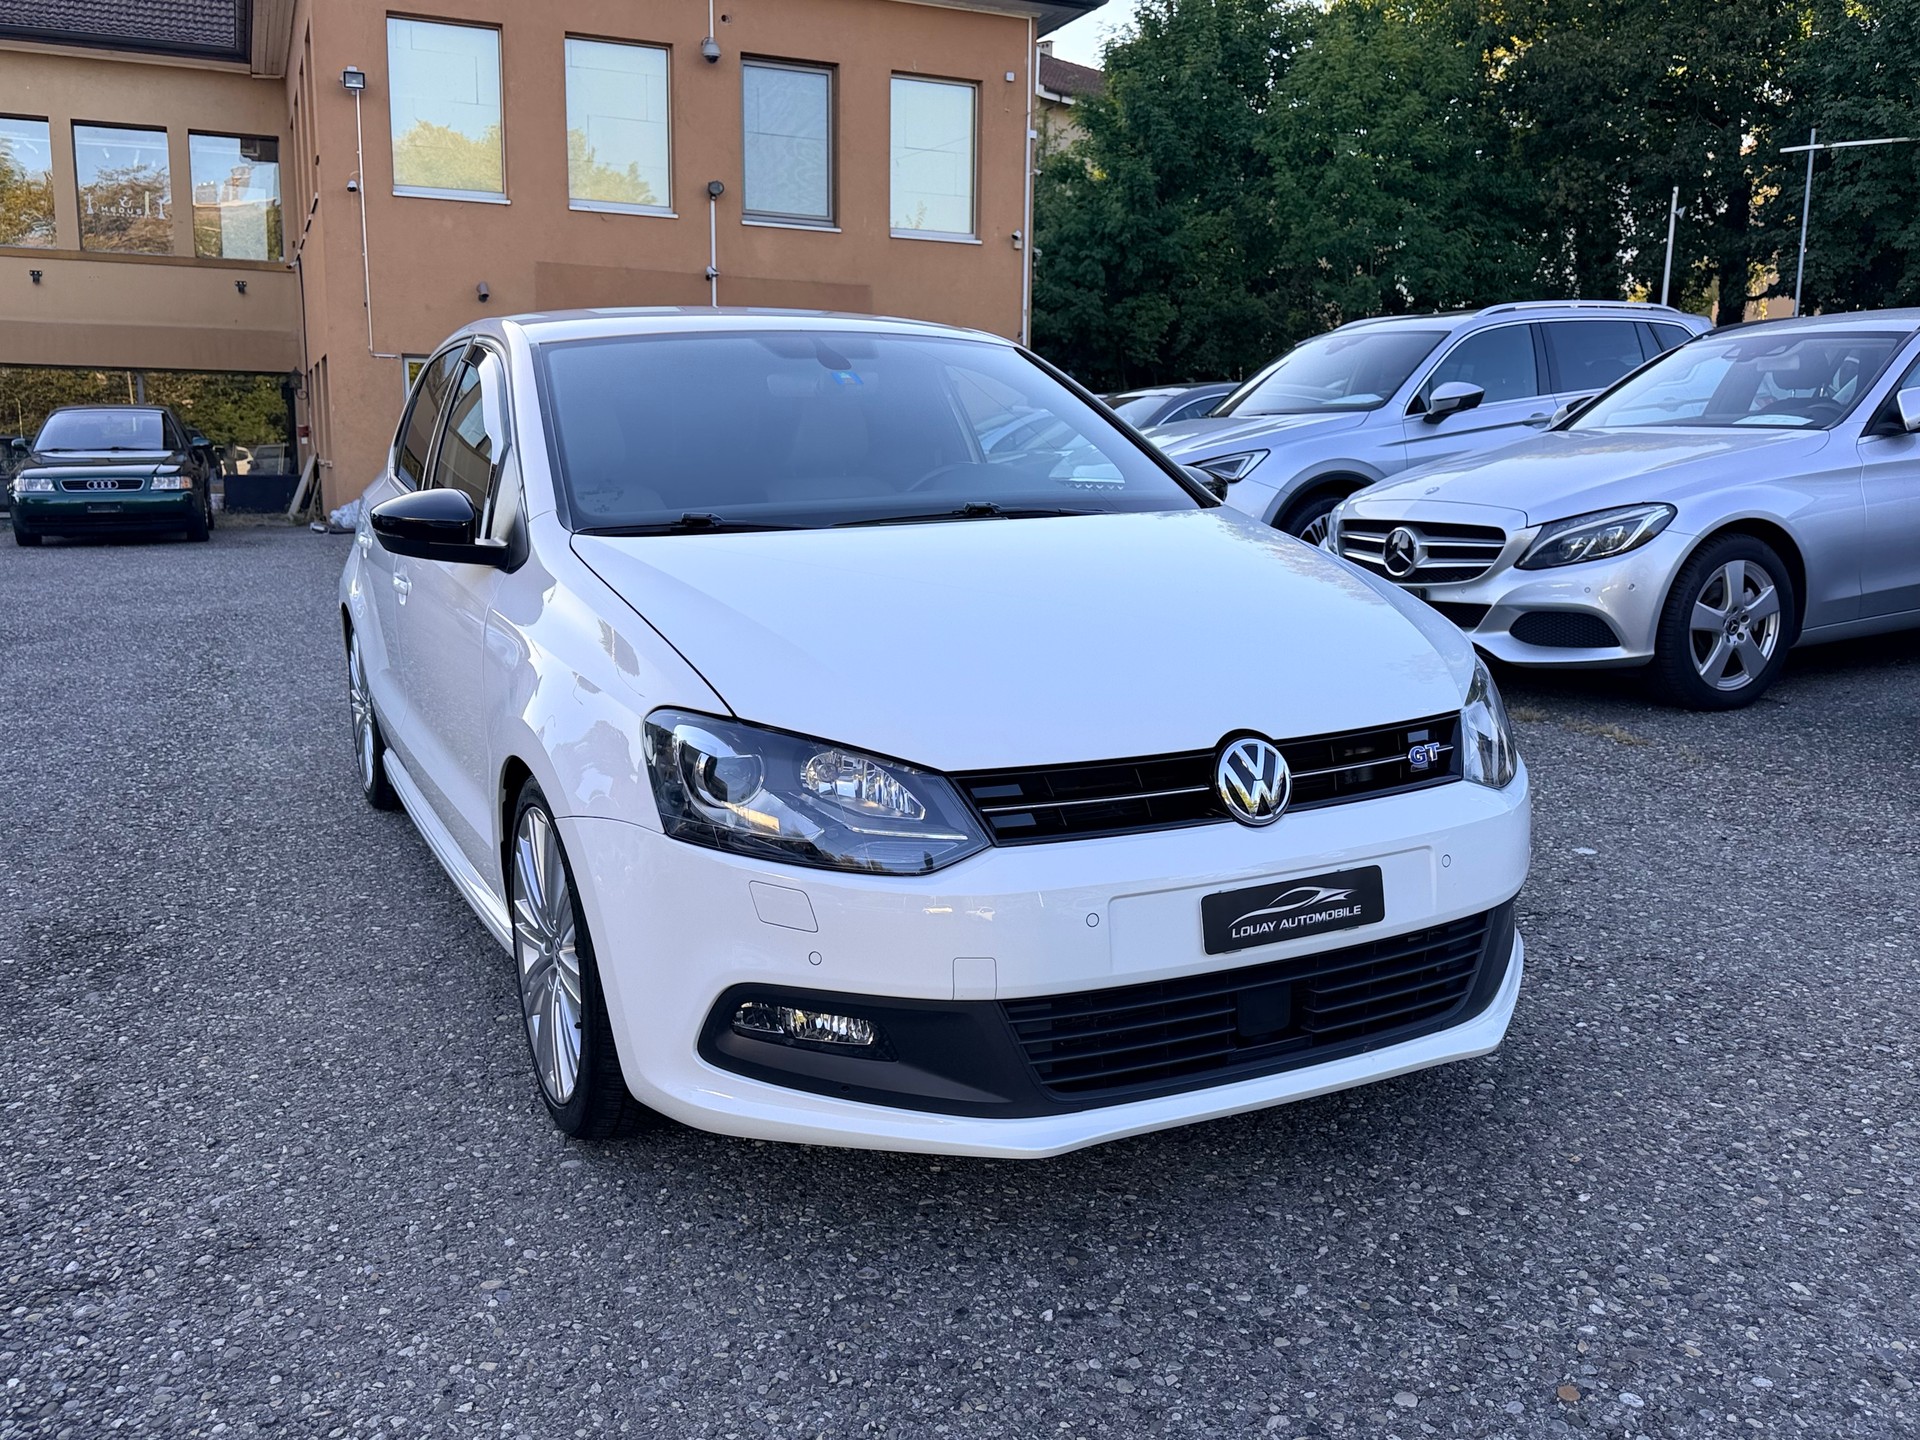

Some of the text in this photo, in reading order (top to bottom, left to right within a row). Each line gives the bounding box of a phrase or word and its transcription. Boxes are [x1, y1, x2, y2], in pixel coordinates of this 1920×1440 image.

[1408, 742, 1440, 765] GT
[1232, 904, 1362, 940] LOUAY AUTOMOBILE
